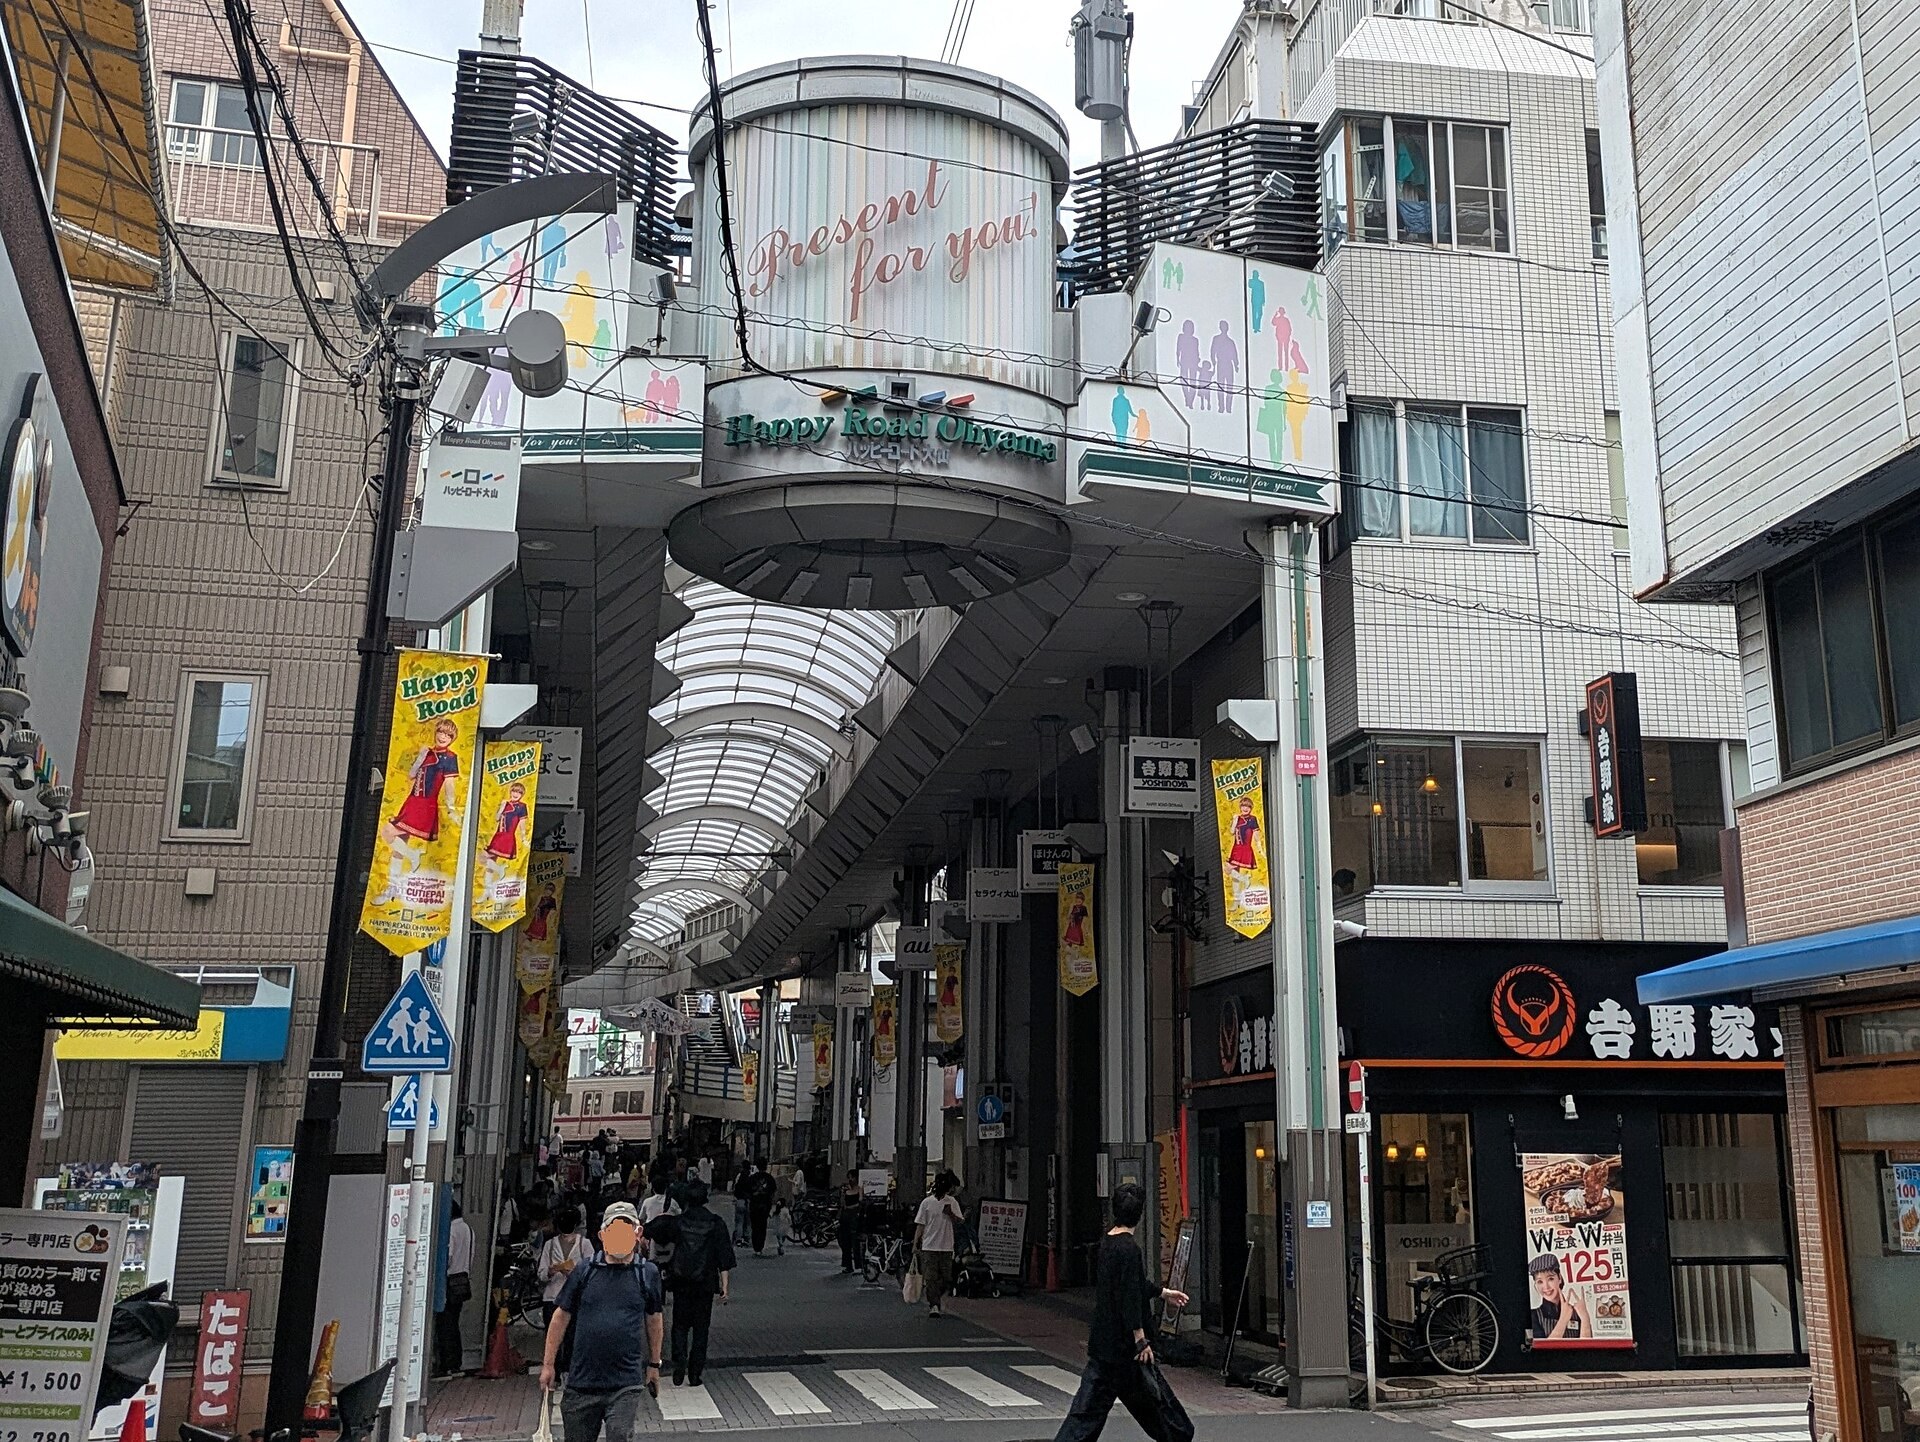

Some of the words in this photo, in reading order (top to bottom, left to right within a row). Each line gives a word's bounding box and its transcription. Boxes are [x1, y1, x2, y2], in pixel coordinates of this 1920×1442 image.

[748, 160, 950, 297] Present
[850, 237, 935, 322] for
[945, 191, 1038, 283] you!
[522, 436, 544, 450] for
[551, 437, 581, 449] you!
[724, 413, 834, 450] Happy
[842, 407, 929, 440] Road
[936, 415, 1058, 465] Ohyama
[443, 485, 498, 498] ハッピーロード大山
[1209, 470, 1248, 485] Present
[1252, 477, 1269, 491] for
[1274, 482, 1298, 493] you!
[401, 665, 478, 699] Happy
[416, 688, 477, 721] Road
[486, 747, 535, 773] Happy
[1141, 760, 1189, 777] 吉野家
[497, 763, 536, 785] Road
[1142, 778, 1188, 788] YOSHINOYA
[1215, 764, 1257, 790] Happy
[1226, 777, 1259, 800] Road
[1033, 849, 1070, 859] ほけんの
[528, 857, 564, 874] Happy
[535, 868, 565, 884] Road
[1060, 868, 1091, 884] Happy
[1066, 878, 1092, 894] Road
[974, 889, 1019, 898] セラヴィ大山
[903, 940, 931, 954] au
[1585, 998, 1759, 1059] 吉野家
[0, 1263, 101, 1282] 質のカラー剤で
[1560, 1249, 1612, 1283] 125
[0, 1300, 64, 1315] ー専門店
[198, 1298, 241, 1418] たばこ
